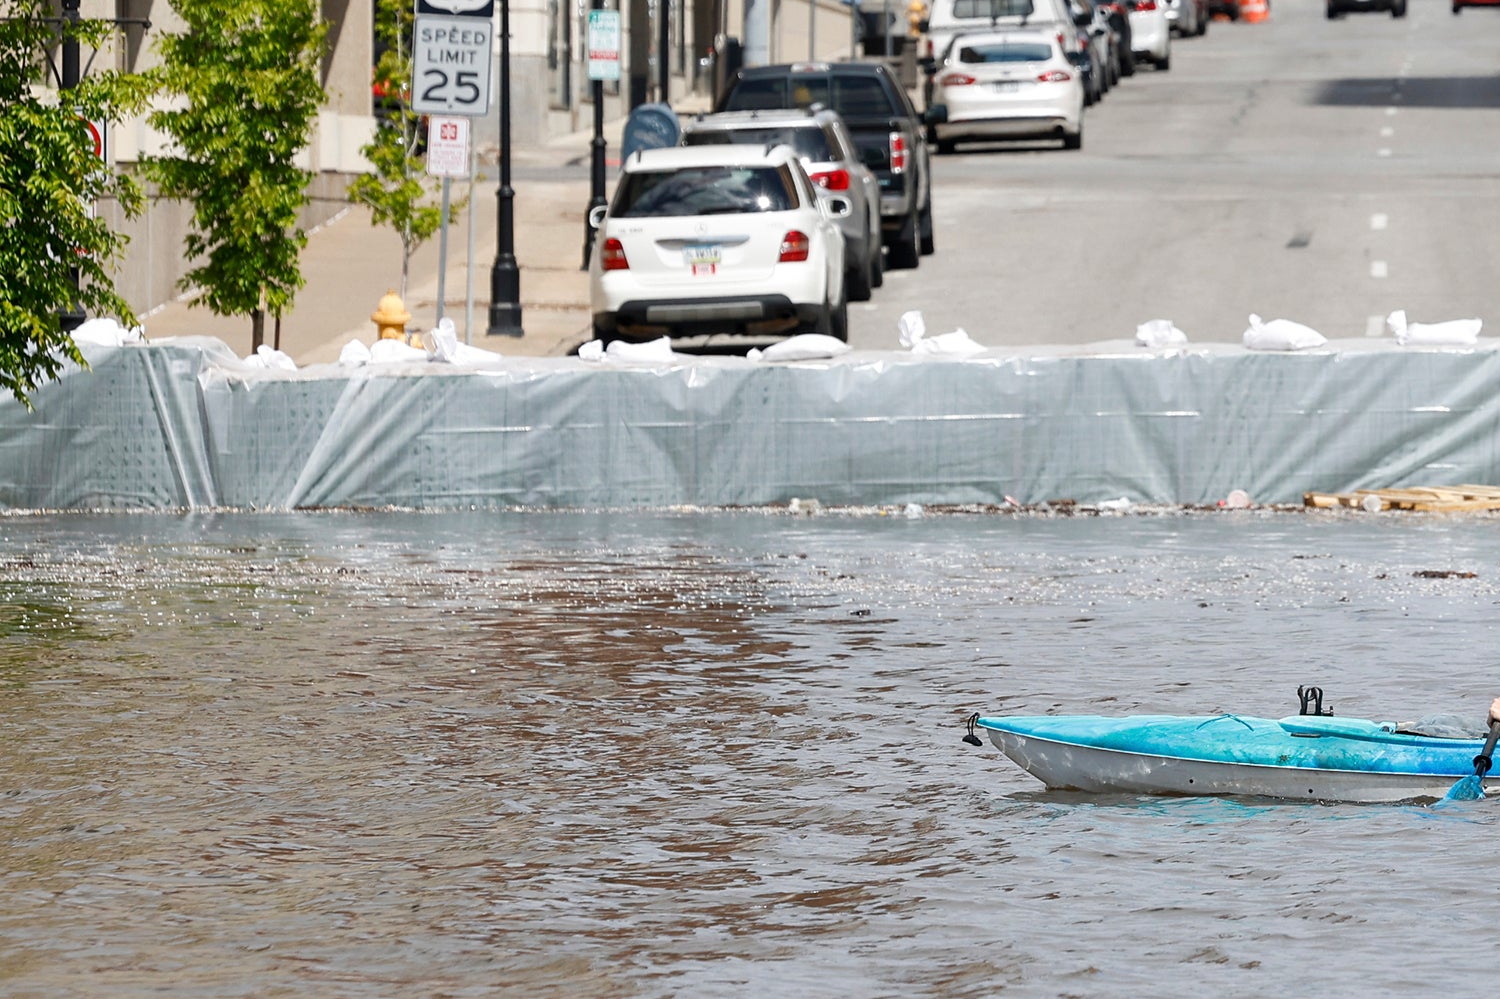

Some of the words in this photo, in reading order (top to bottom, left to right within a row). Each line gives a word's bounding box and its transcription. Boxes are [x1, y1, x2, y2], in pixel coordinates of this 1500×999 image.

[421, 27, 486, 47] SPEED
[426, 49, 477, 65] LIMIT
[421, 69, 480, 105] 25
